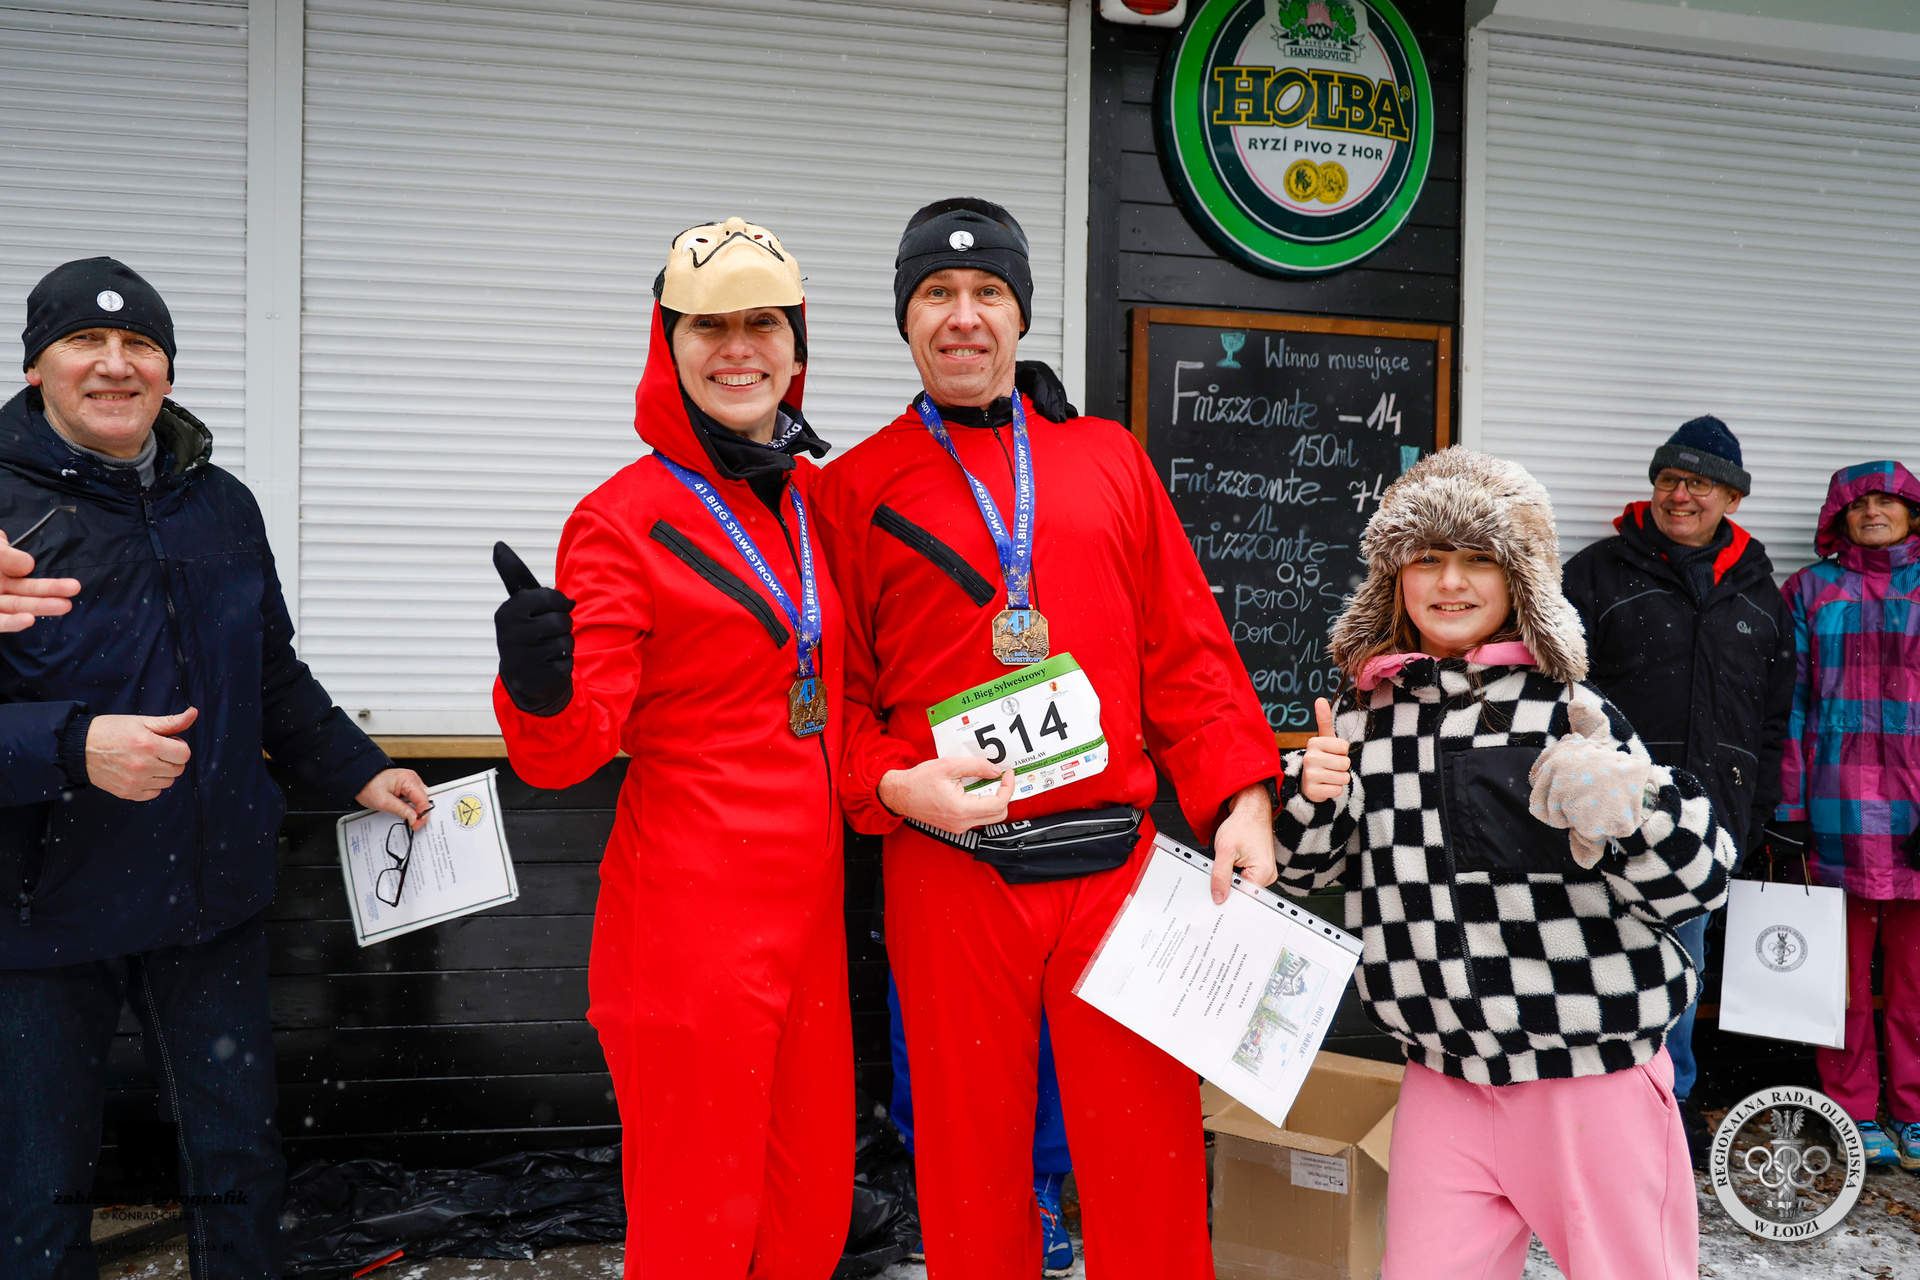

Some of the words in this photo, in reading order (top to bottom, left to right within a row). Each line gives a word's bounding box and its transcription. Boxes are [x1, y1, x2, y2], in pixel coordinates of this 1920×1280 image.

[1213, 66, 1409, 142] HOLBA
[1247, 135, 1288, 152] RYZÍ
[1293, 139, 1333, 155] PIVO
[1337, 142, 1348, 157] Z
[1351, 146, 1384, 161] HOR
[1264, 336, 1320, 369] Winno
[1327, 346, 1410, 381] musujące
[1171, 360, 1319, 430] Frizzante
[1017, 443, 1030, 511] SYLWESTROWY
[1288, 432, 1360, 469] 150ml
[693, 481, 730, 521] 41.BIEG
[725, 521, 785, 599] SYLWESTROWY
[795, 499, 814, 576] SYLWESTROWY
[1016, 514, 1029, 558] 41.BIEG
[806, 579, 818, 623] 41.BIEG
[974, 687, 994, 701] Bieg
[993, 667, 1047, 694] Sylwestrowy
[973, 700, 1068, 765] 514
